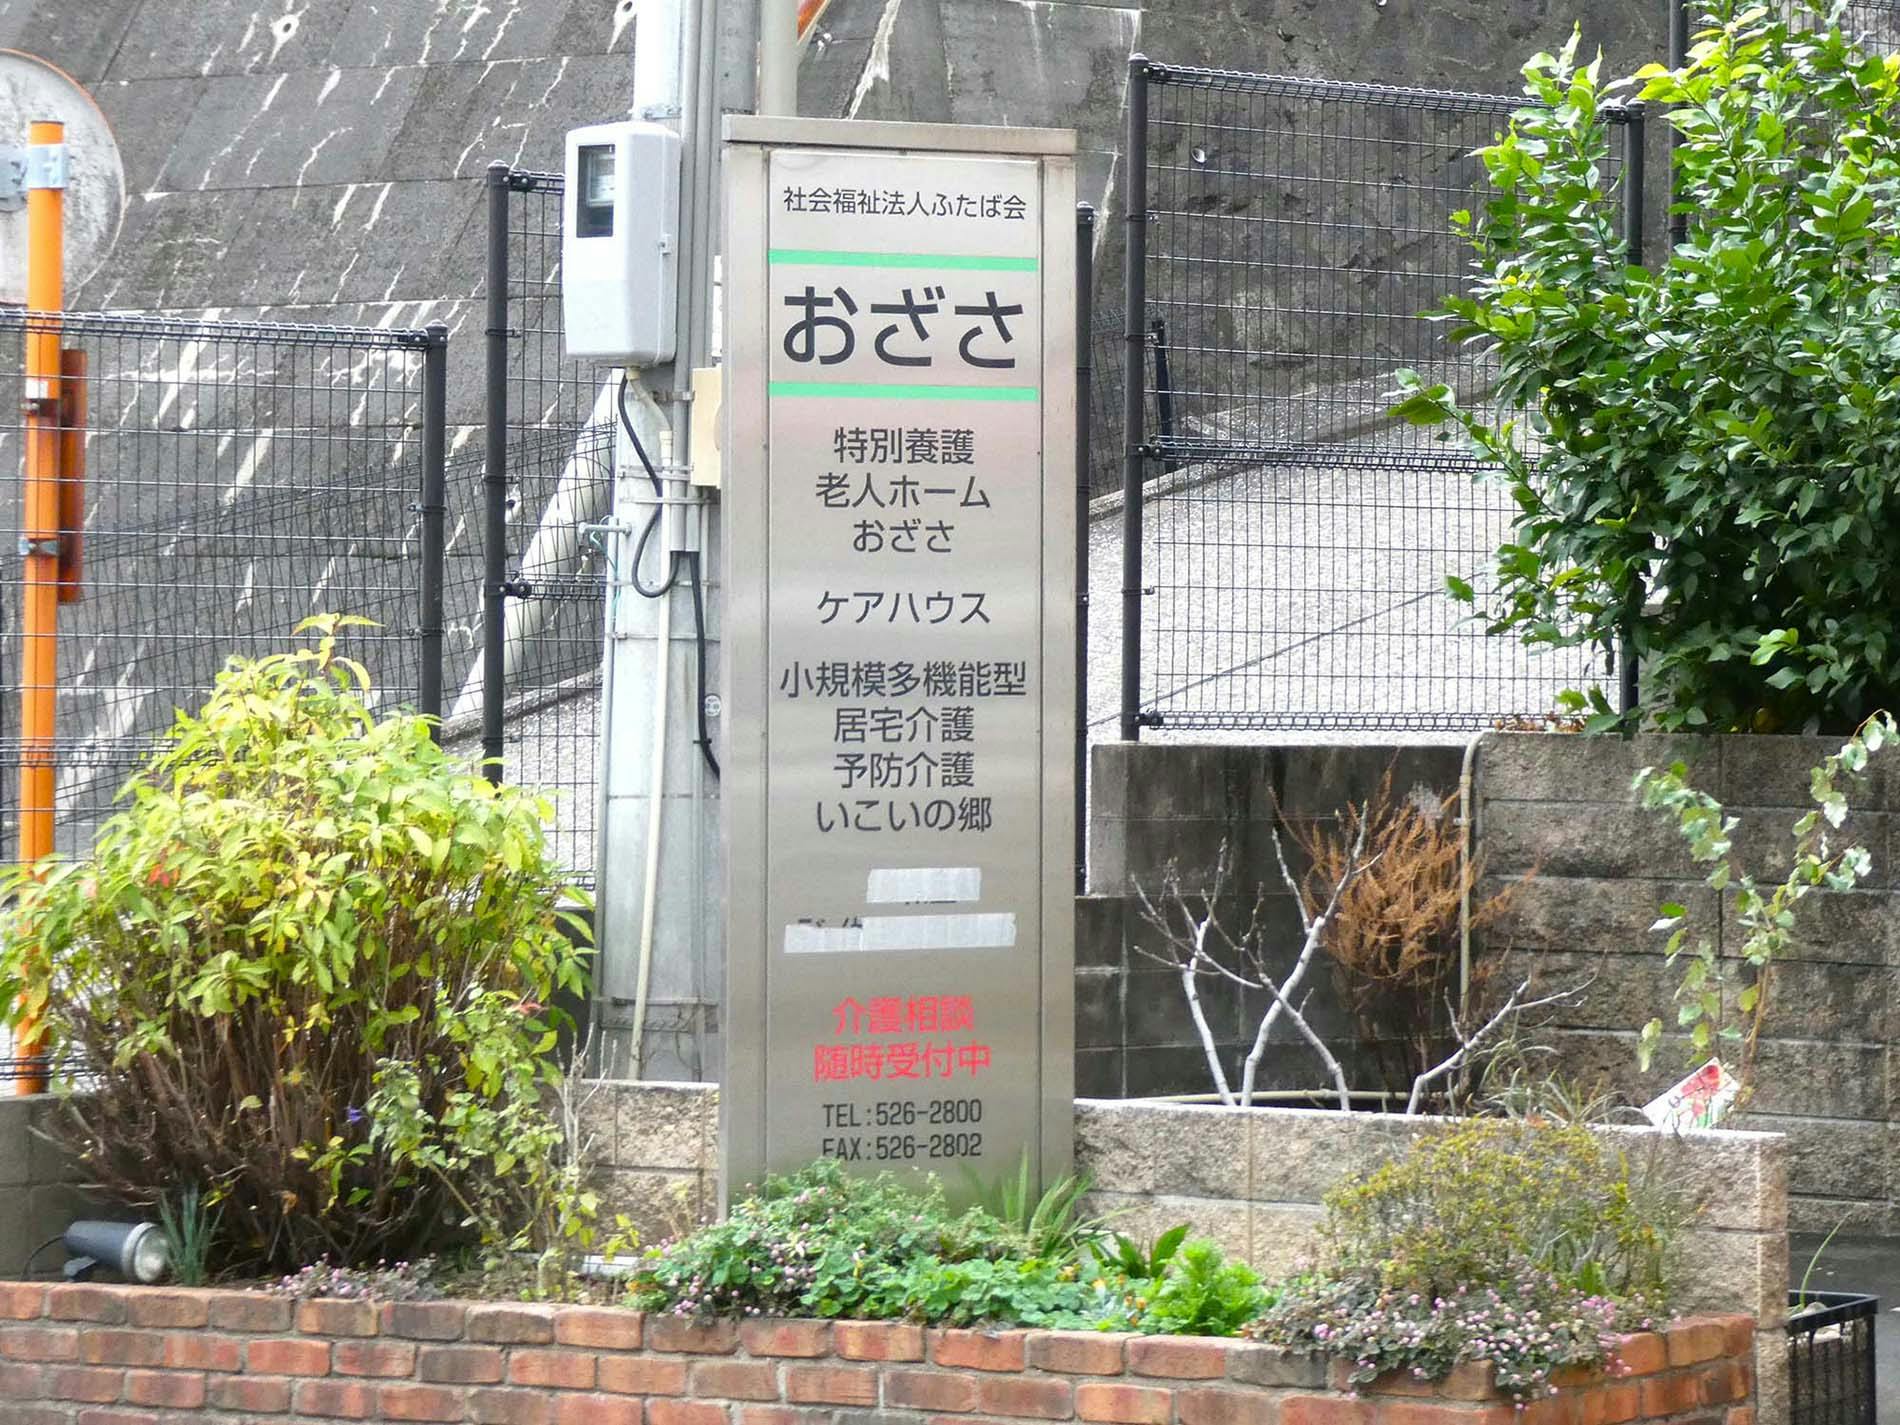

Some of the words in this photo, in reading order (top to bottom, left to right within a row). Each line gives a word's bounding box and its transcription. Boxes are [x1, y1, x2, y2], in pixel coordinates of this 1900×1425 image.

[783, 186, 1026, 220] 社会福祉法人ふたば会
[783, 286, 1024, 369] おざさ
[833, 427, 975, 465] 特別養護
[815, 472, 991, 508] 老人ホーム
[852, 519, 955, 553] おざさ
[816, 591, 991, 625] ケアハウス
[779, 660, 1027, 698] 小規模多機能型
[833, 706, 975, 743] 居宅介護
[833, 751, 975, 788] 予防介護
[816, 796, 992, 833] いこいの郷
[832, 994, 975, 1036] 介護相談
[814, 1040, 992, 1083] 随時受付中
